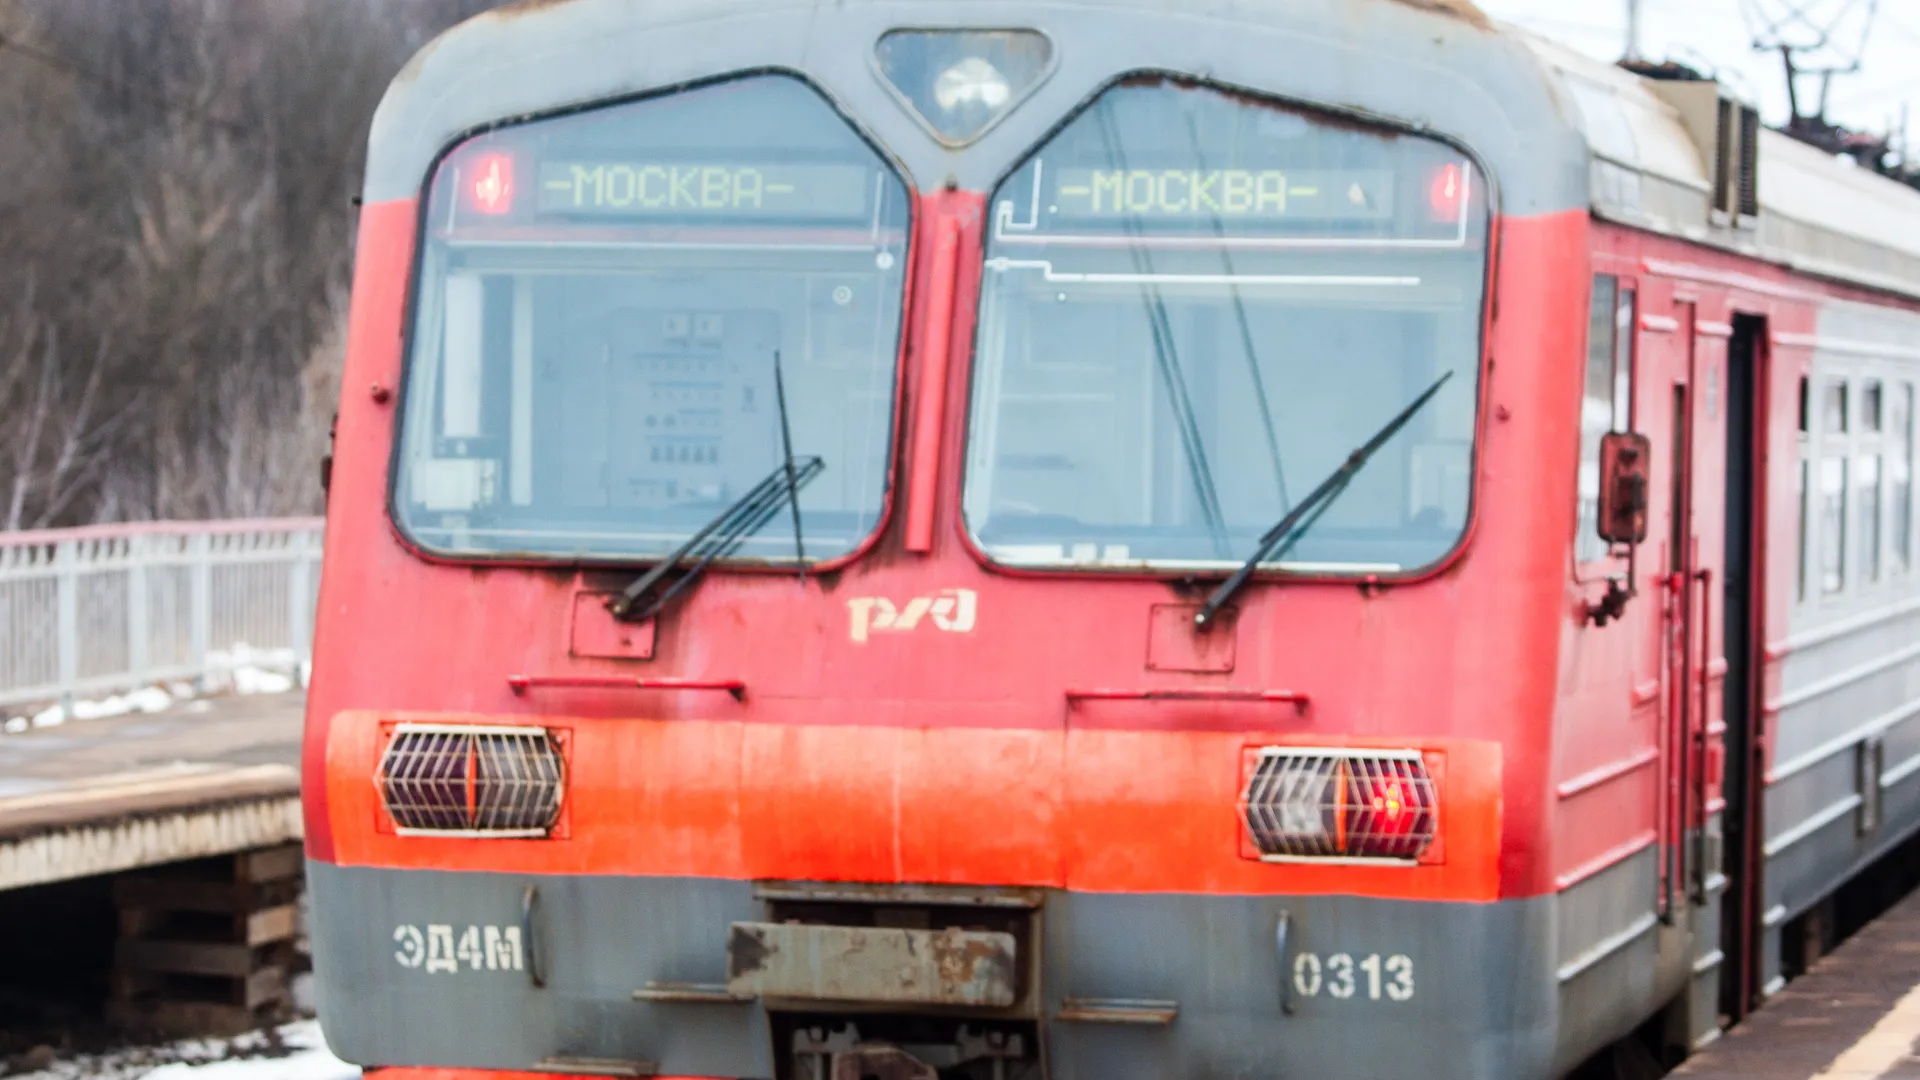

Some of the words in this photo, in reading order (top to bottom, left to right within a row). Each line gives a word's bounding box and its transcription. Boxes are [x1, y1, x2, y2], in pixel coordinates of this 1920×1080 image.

[545, 164, 794, 207] -МОСКВА-
[1061, 170, 1318, 212] -МОСКВА-
[393, 923, 524, 974] ЭД4М
[1292, 952, 1416, 1001] 0313
